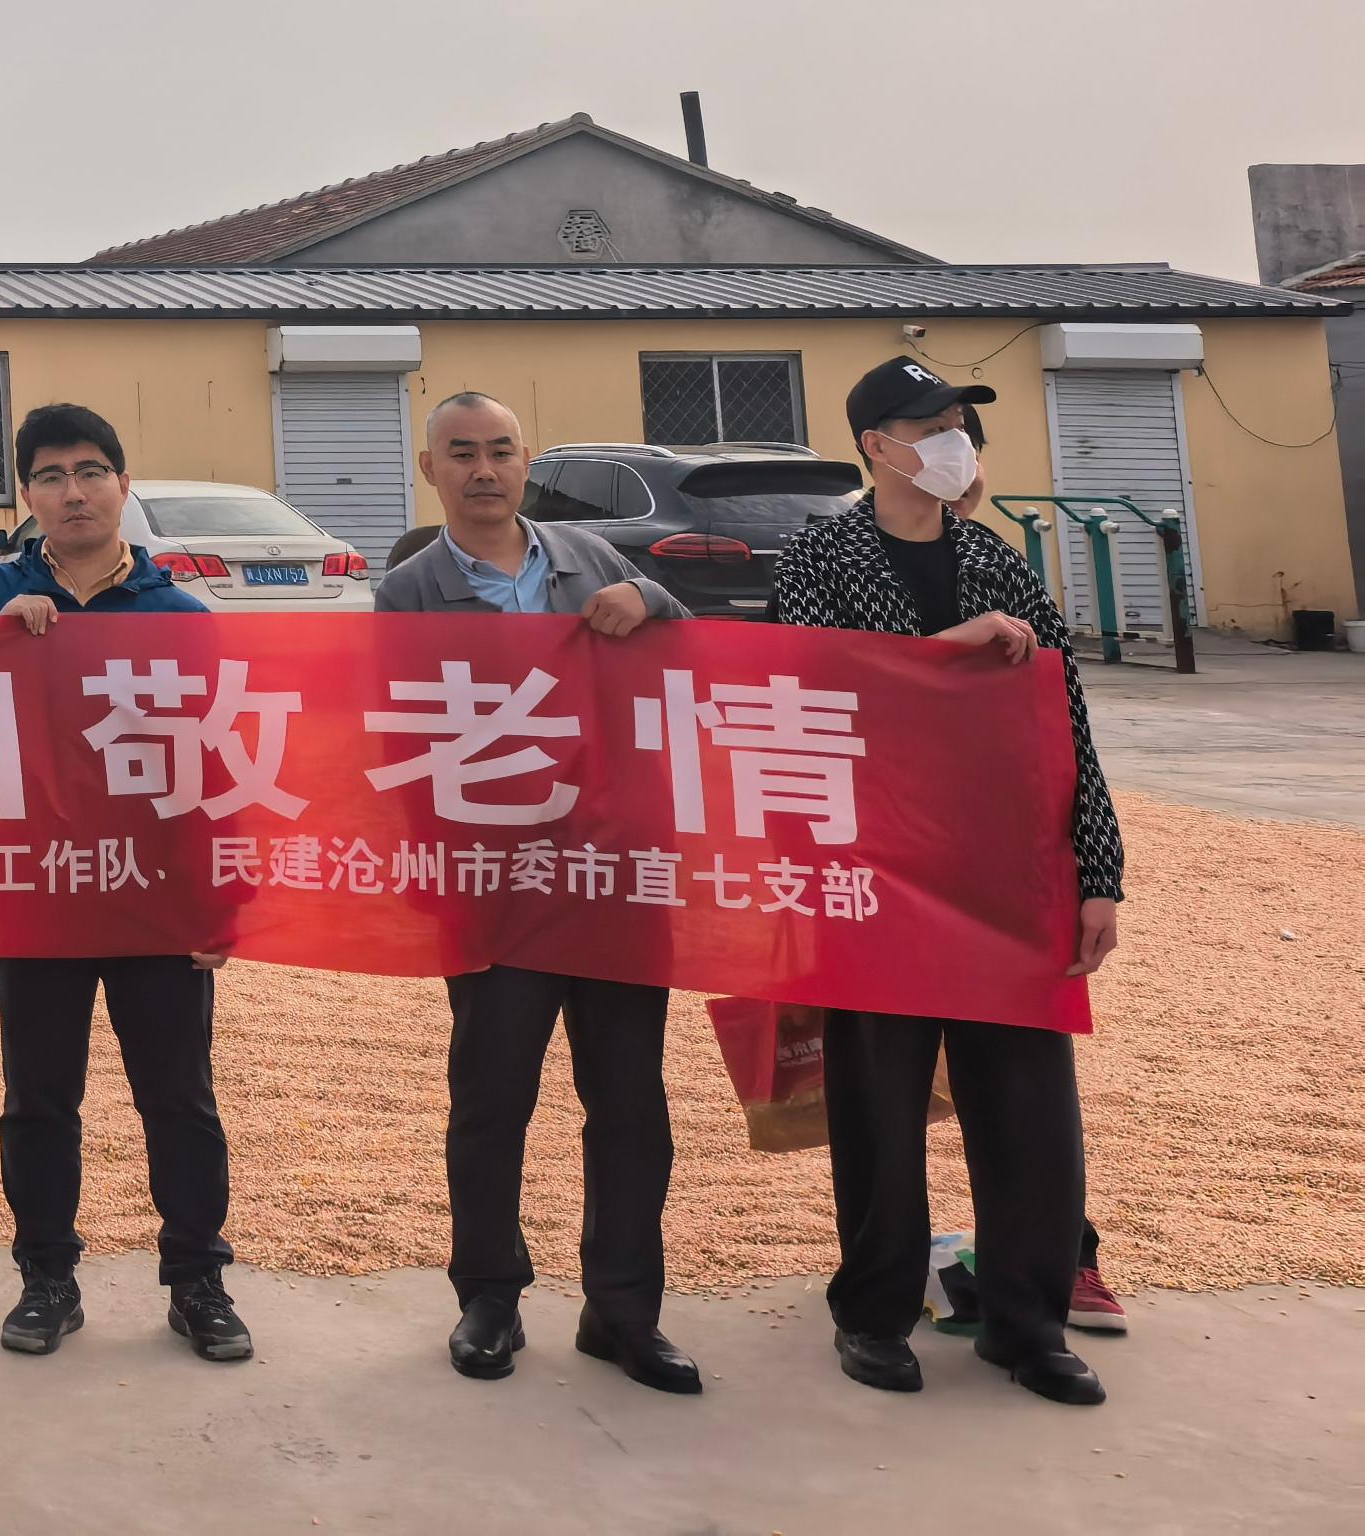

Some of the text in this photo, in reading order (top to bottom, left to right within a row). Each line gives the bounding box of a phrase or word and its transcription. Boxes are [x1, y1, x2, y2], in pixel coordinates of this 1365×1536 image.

[211, 834, 879, 922] 民建沧州市委市直七支部
